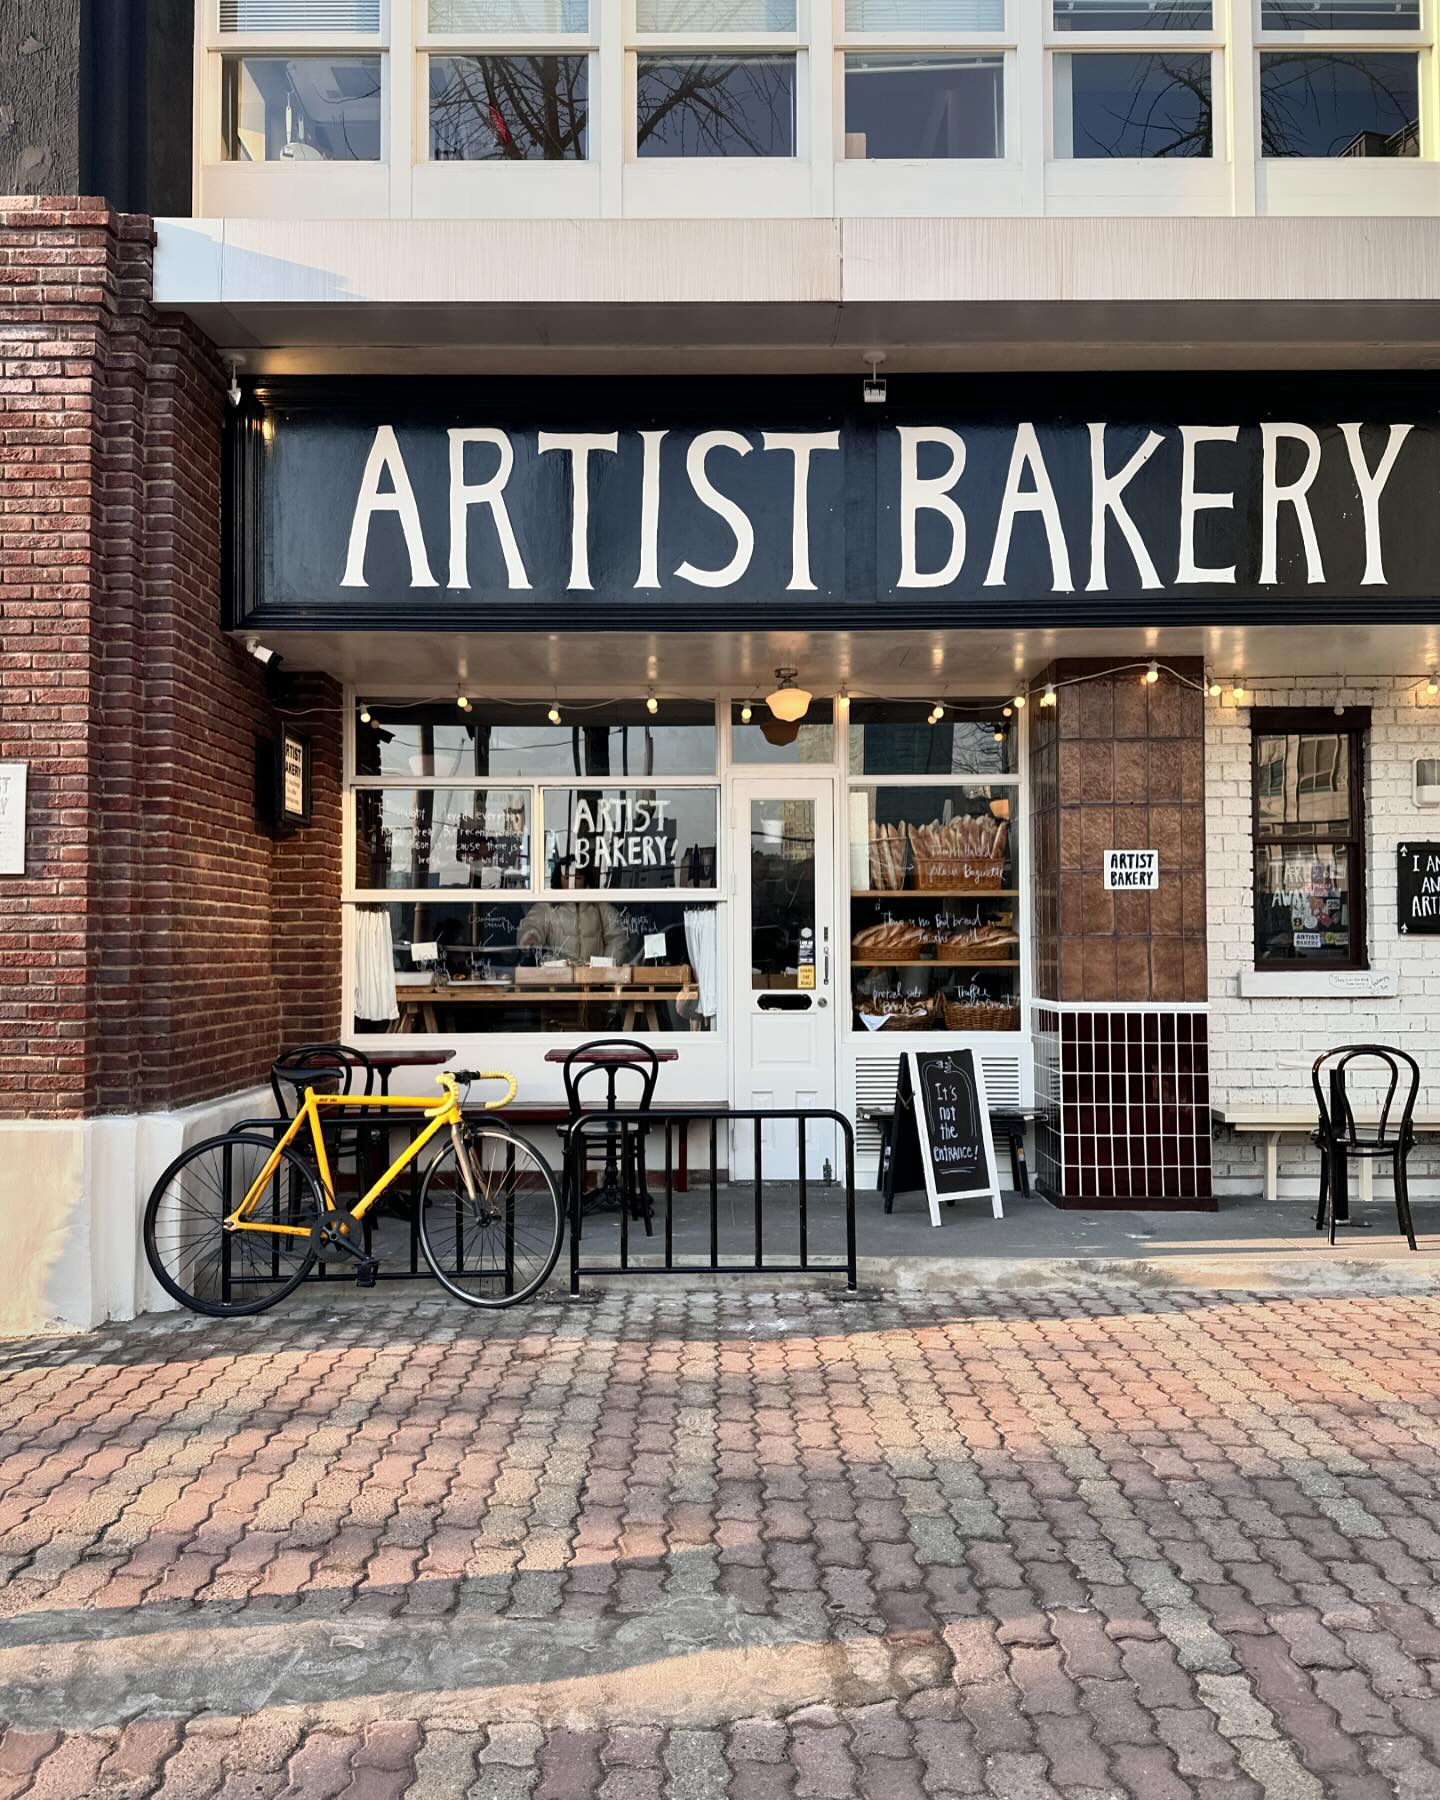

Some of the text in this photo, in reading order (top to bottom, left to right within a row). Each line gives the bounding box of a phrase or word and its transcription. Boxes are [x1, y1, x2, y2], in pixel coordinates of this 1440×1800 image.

[339, 421, 1416, 593] ARTIST BAKERY
[573, 797, 671, 833] ARTIST
[574, 835, 679, 869] BAKERY!
[1110, 852, 1154, 870] ARTIST
[1413, 855, 1420, 872] I
[1110, 870, 1154, 887] BAKERY
[934, 1082, 958, 1101] It's
[939, 1105, 956, 1121] not
[940, 1122, 959, 1140] the
